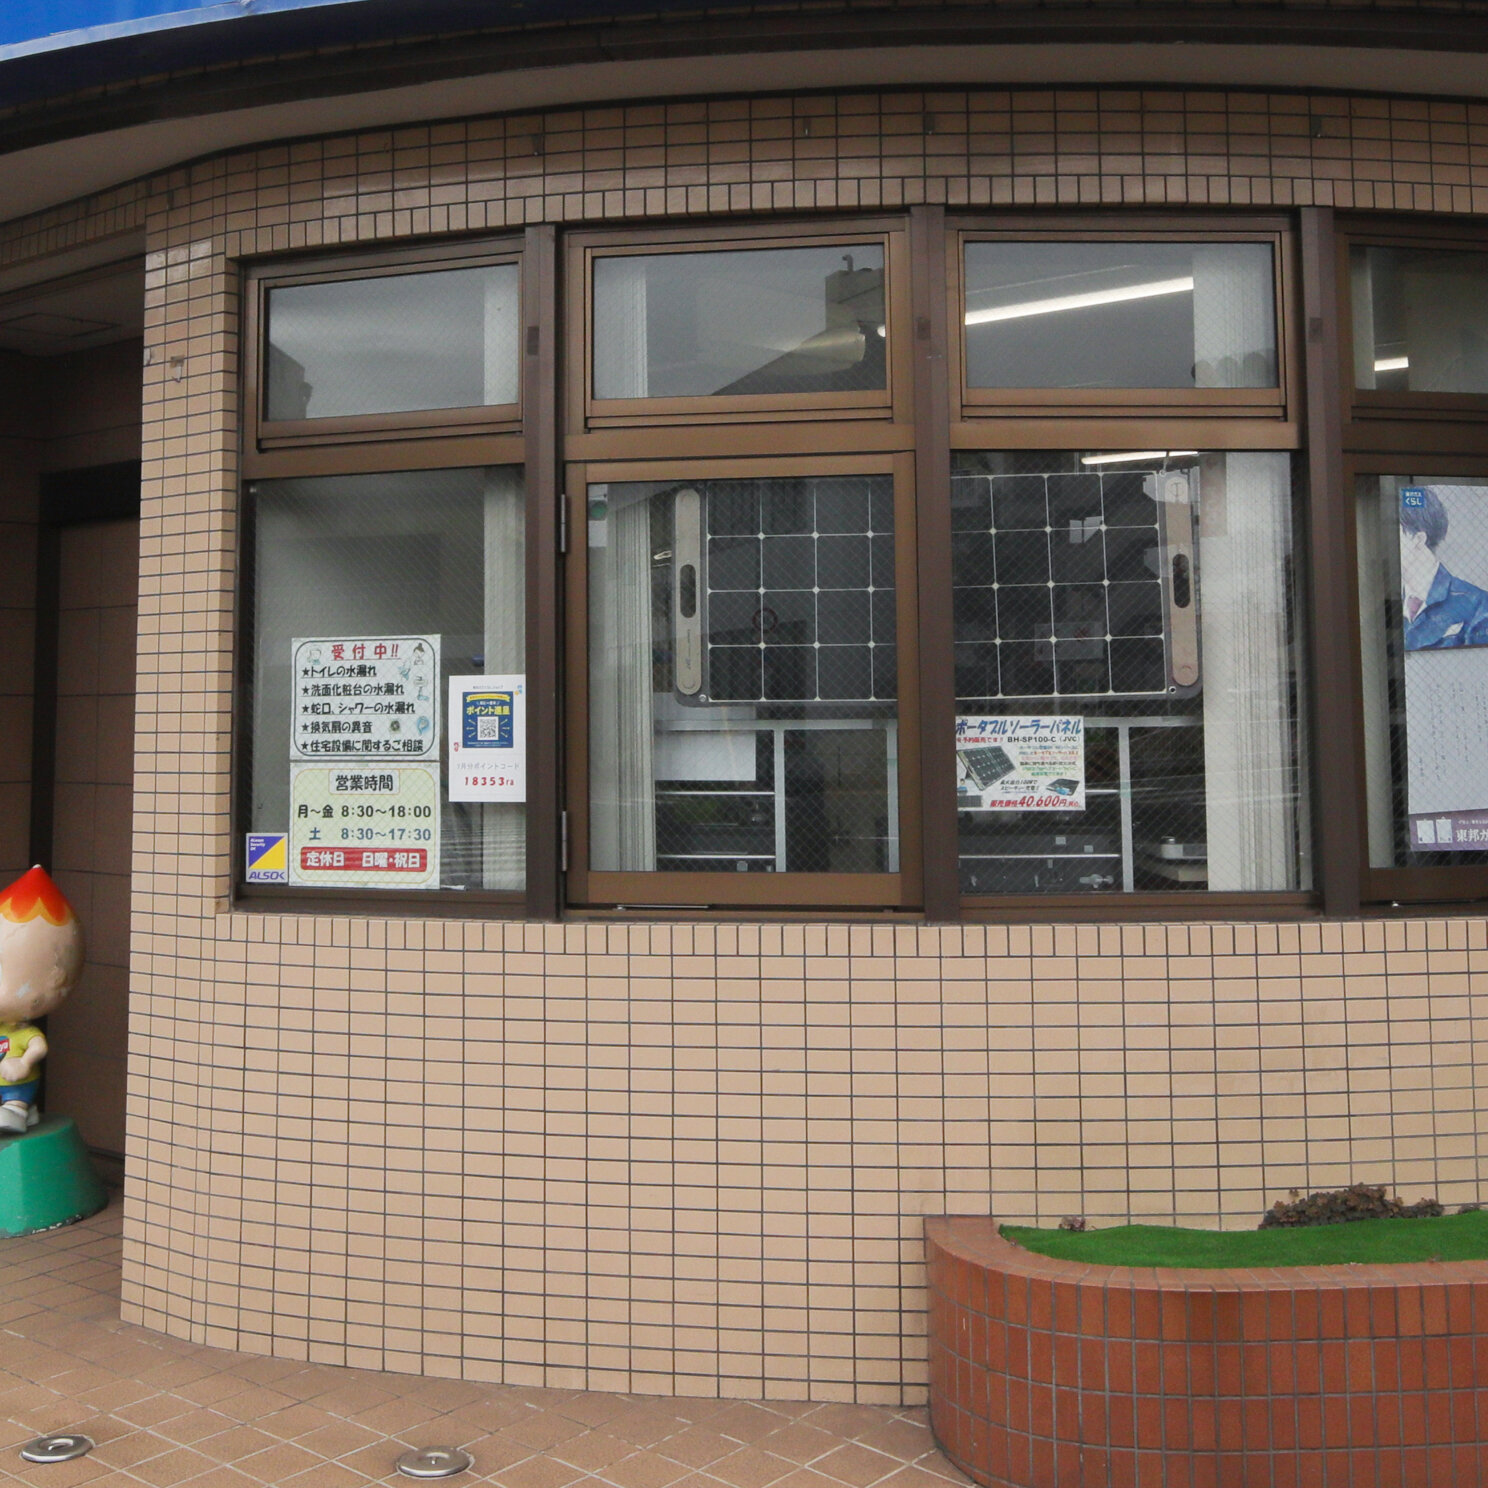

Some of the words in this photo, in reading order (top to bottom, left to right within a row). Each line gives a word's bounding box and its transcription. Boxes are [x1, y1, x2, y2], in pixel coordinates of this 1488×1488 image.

[310, 721, 372, 733] 換気扇の異音
[310, 739, 424, 752] 住宅設備に関するご相談
[336, 775, 394, 791] 営業時間
[309, 827, 321, 840] 土
[306, 851, 344, 866] 定休日
[362, 852, 421, 867] 日曜・祝日
[249, 871, 285, 880] ALSOK
